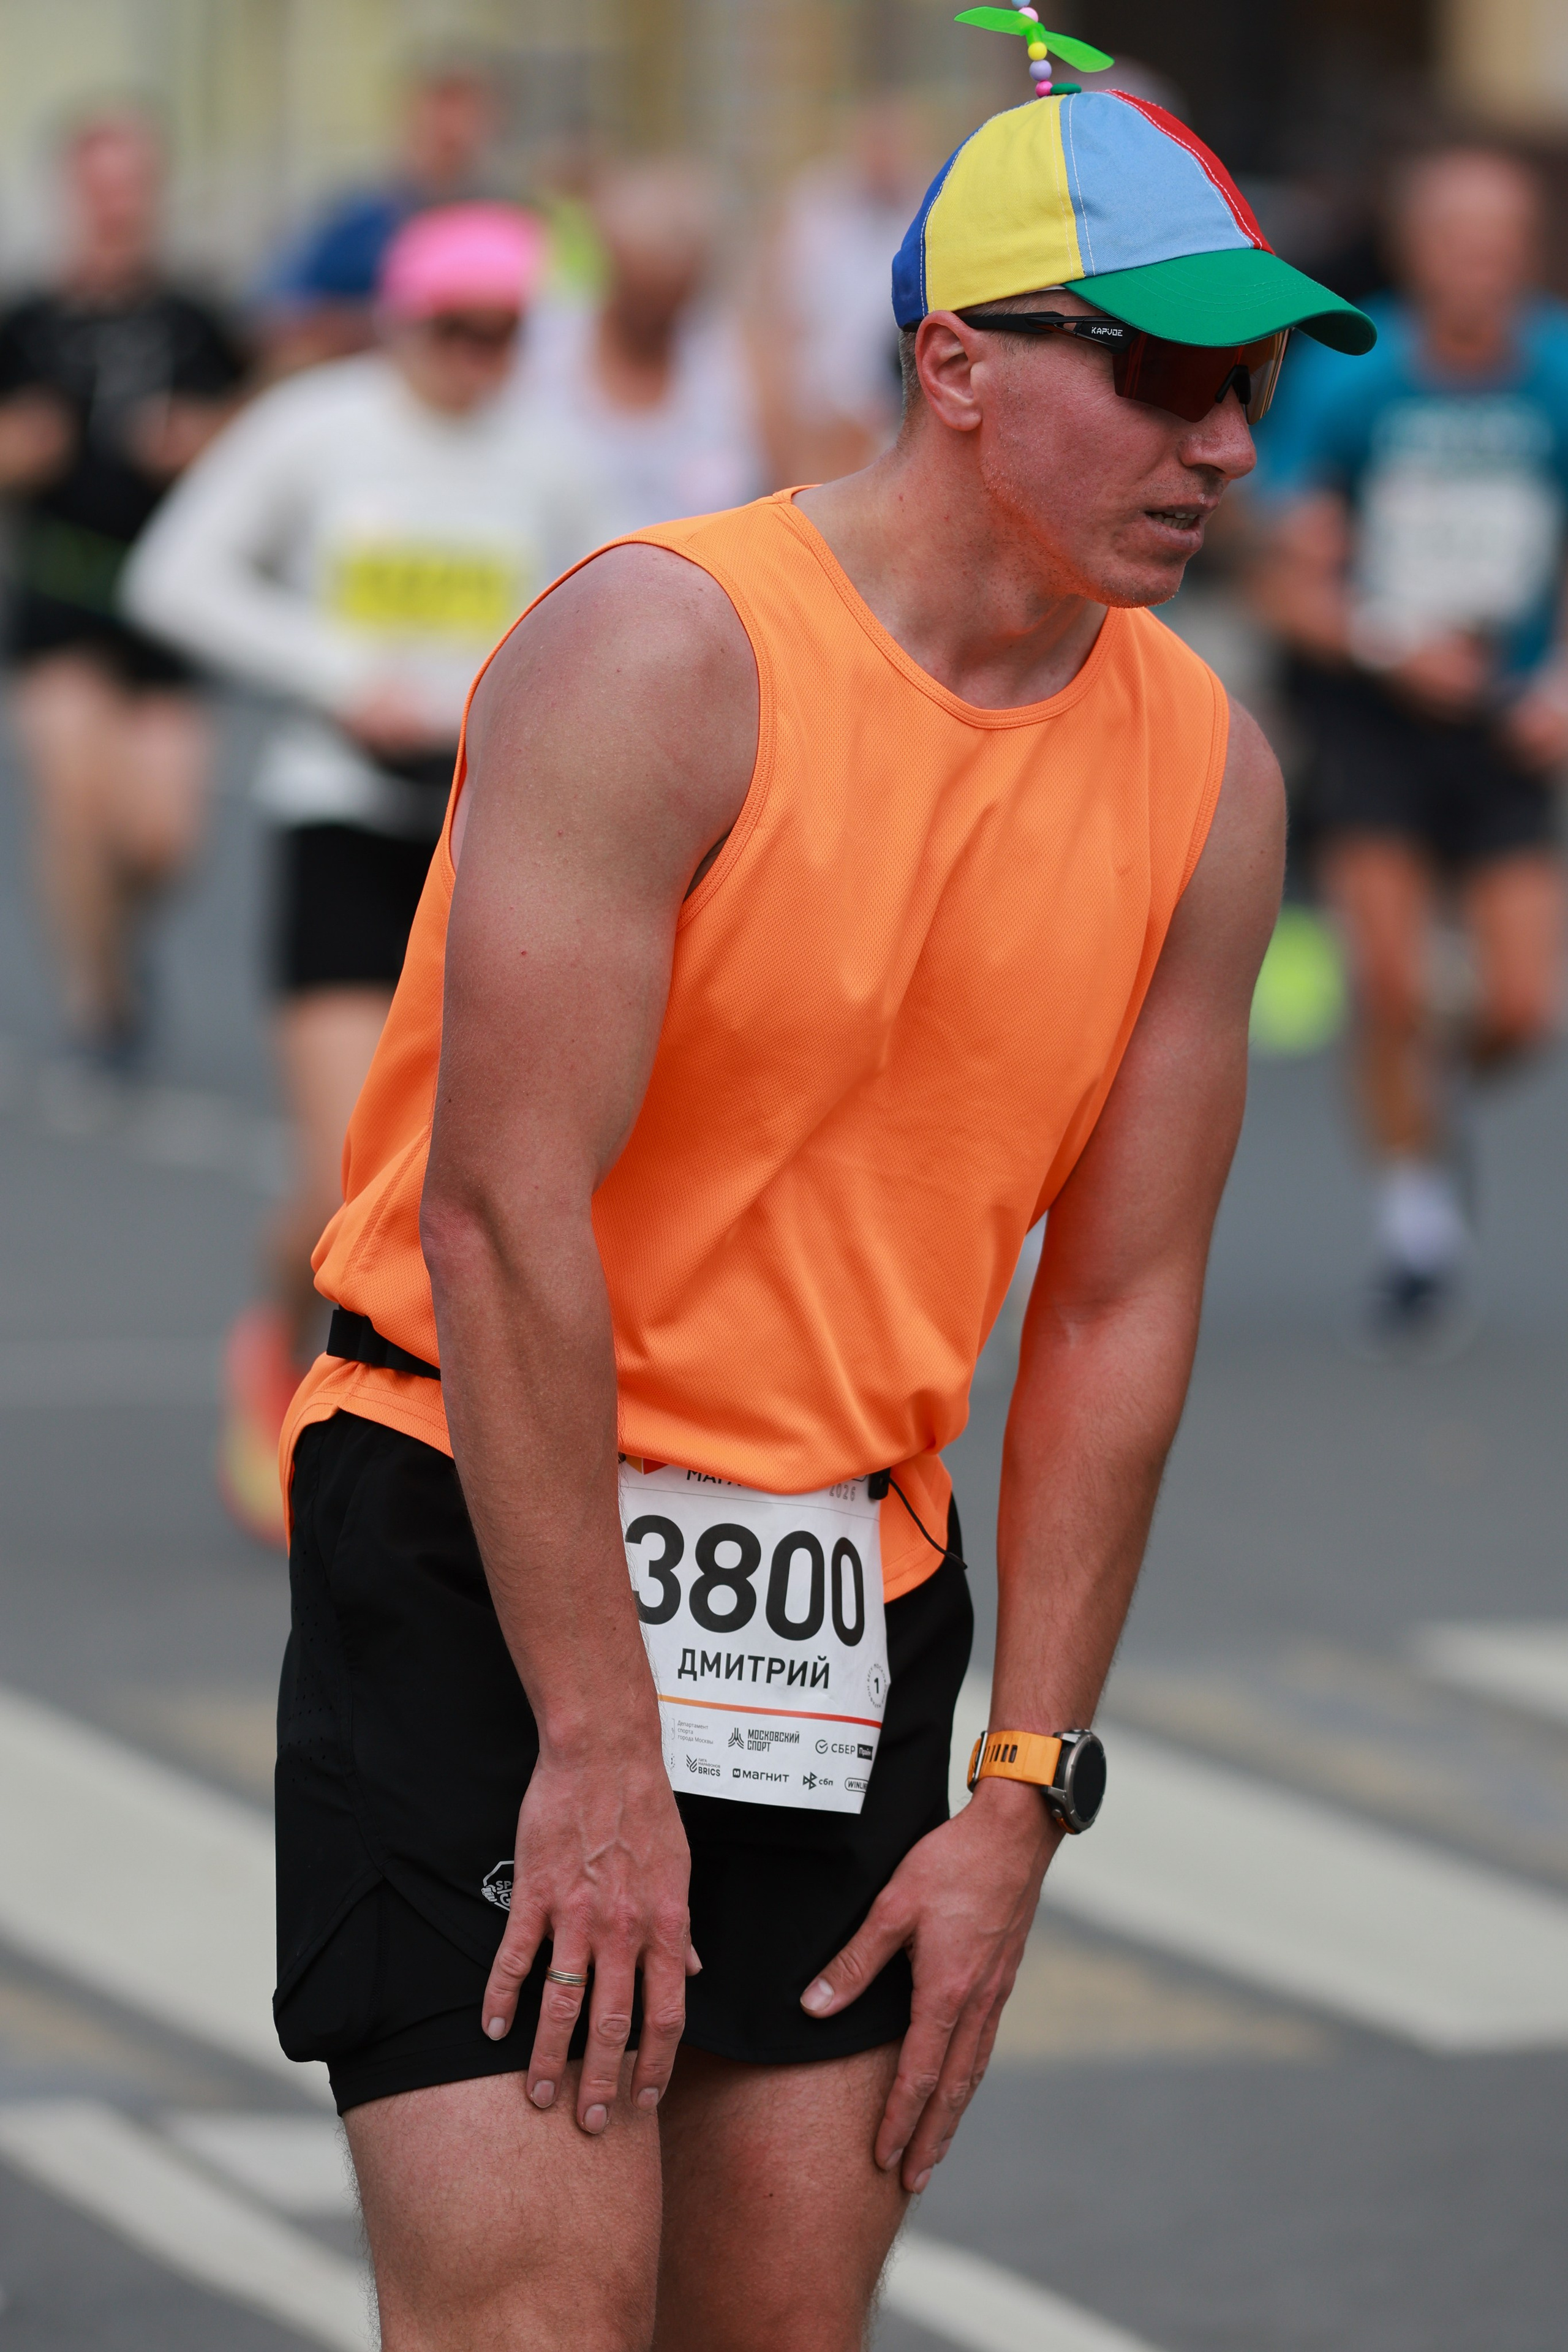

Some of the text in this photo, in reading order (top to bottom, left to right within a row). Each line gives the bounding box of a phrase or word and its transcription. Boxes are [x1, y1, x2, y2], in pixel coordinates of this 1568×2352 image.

[1091, 326, 1123, 337] KAPVOE
[625, 1514, 865, 1647] 3800
[677, 1648, 830, 1689] ДМИТРИЙ
[874, 1677, 879, 1694] 1
[677, 1720, 709, 1730] Департамент
[747, 1728, 800, 1744] МОСКОВСКИЙ
[747, 1740, 771, 1752] СПОРТ
[831, 1743, 856, 1754] СБЕР
[698, 1766, 720, 1777] BRICS
